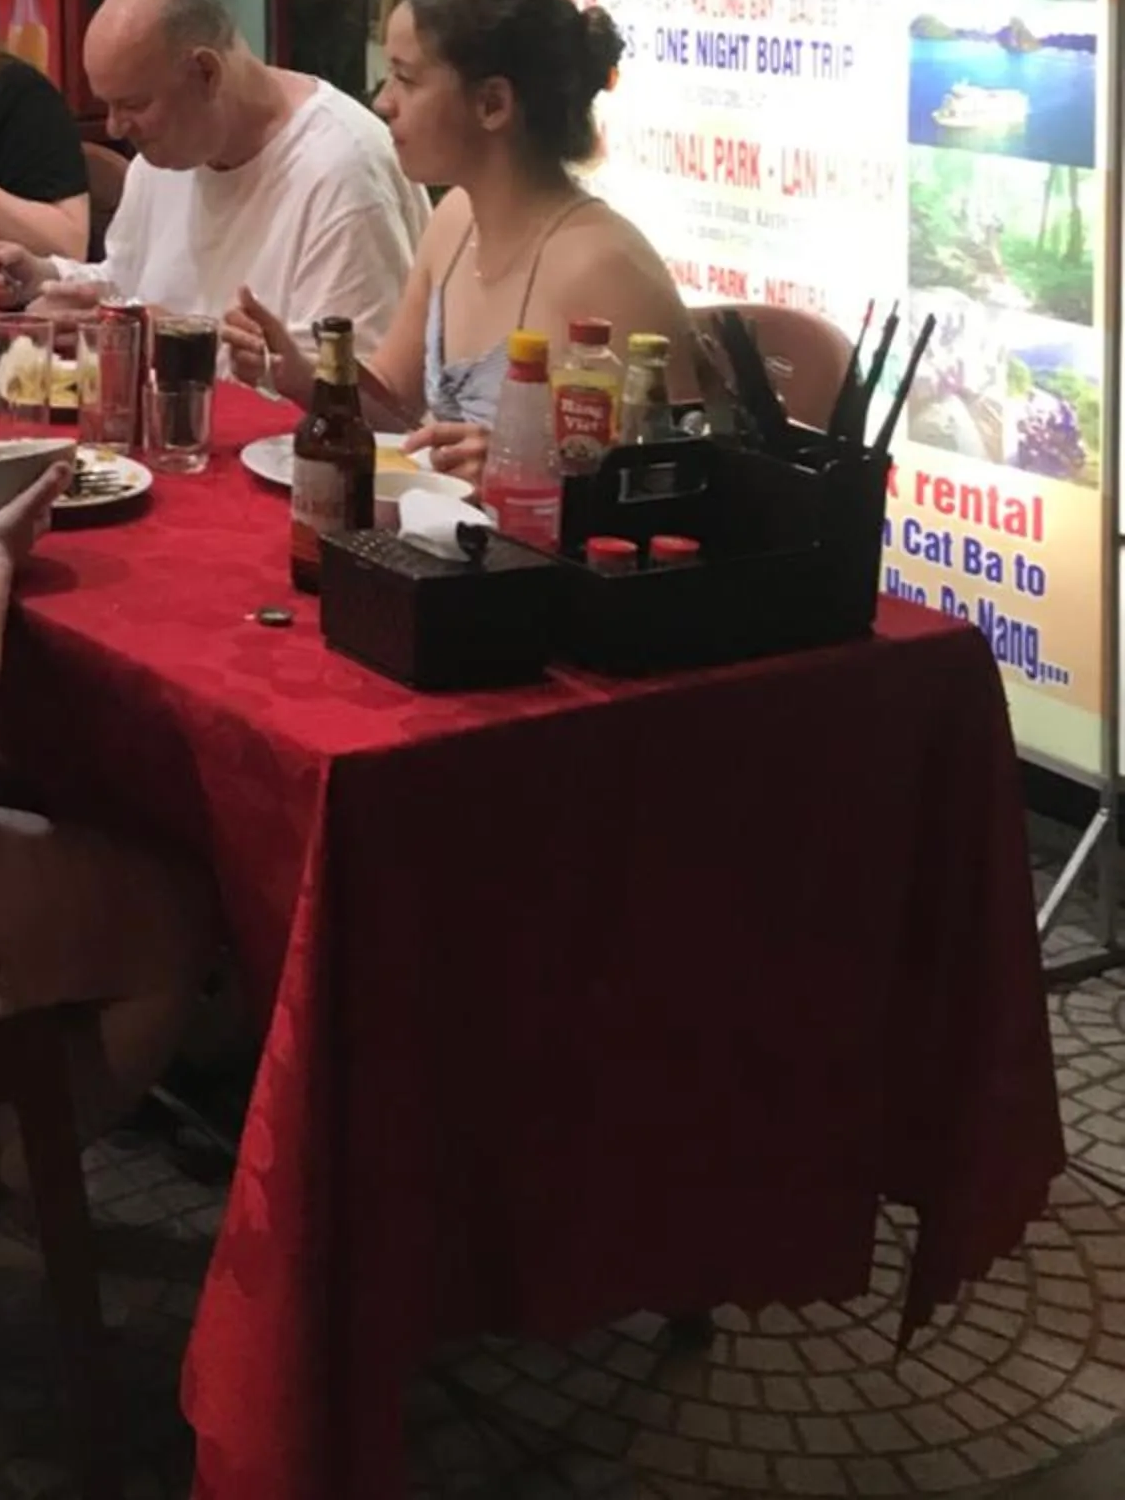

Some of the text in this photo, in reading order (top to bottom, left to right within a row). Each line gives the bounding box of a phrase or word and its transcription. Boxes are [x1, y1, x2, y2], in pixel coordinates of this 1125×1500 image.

[655, 26, 689, 64] ONE
[696, 29, 750, 72] NIGHT
[756, 35, 804, 78] BOAT
[811, 40, 855, 81] TRIP
[713, 135, 762, 191] PARK
[781, 145, 818, 198] LAN
[707, 264, 749, 301] PARK
[915, 470, 1044, 542] rental
[902, 517, 954, 568] Cat
[962, 536, 1004, 583] Ba
[1014, 553, 1047, 597] to
